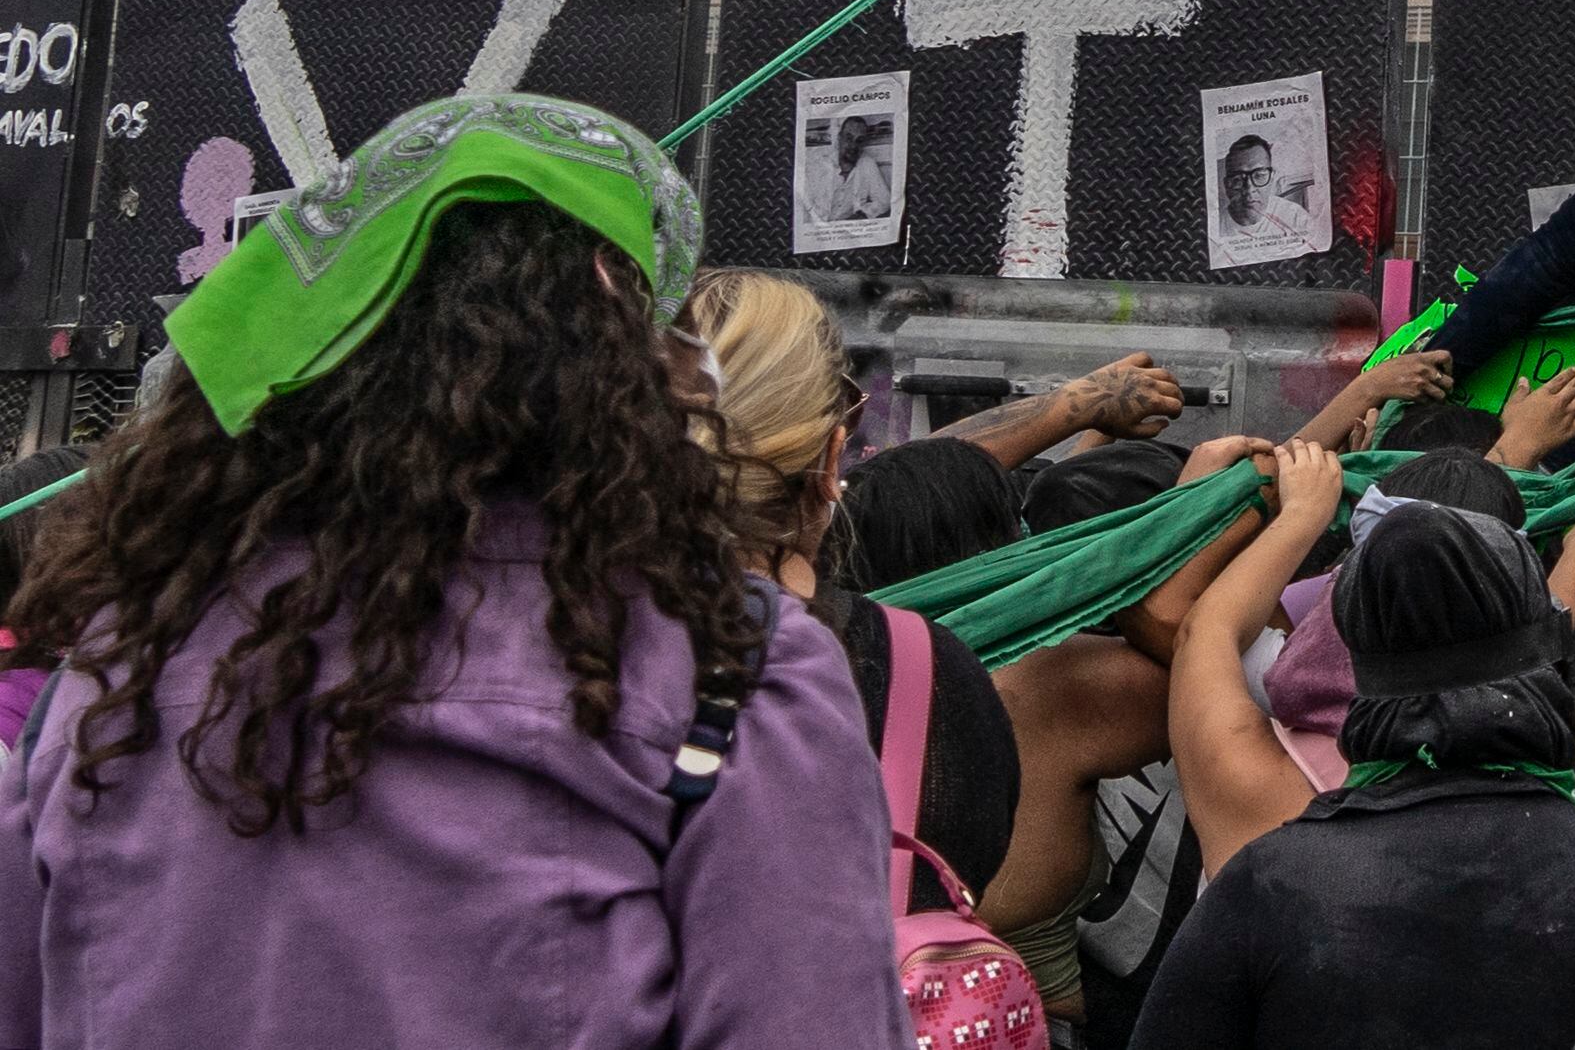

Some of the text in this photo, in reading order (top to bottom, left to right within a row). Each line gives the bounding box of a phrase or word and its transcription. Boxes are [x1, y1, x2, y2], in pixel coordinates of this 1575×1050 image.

[811, 91, 891, 105] ROGELIO CAMPOS
[1217, 94, 1309, 115] BENJAMÍN ROSALES
[1251, 111, 1276, 121] LUNA
